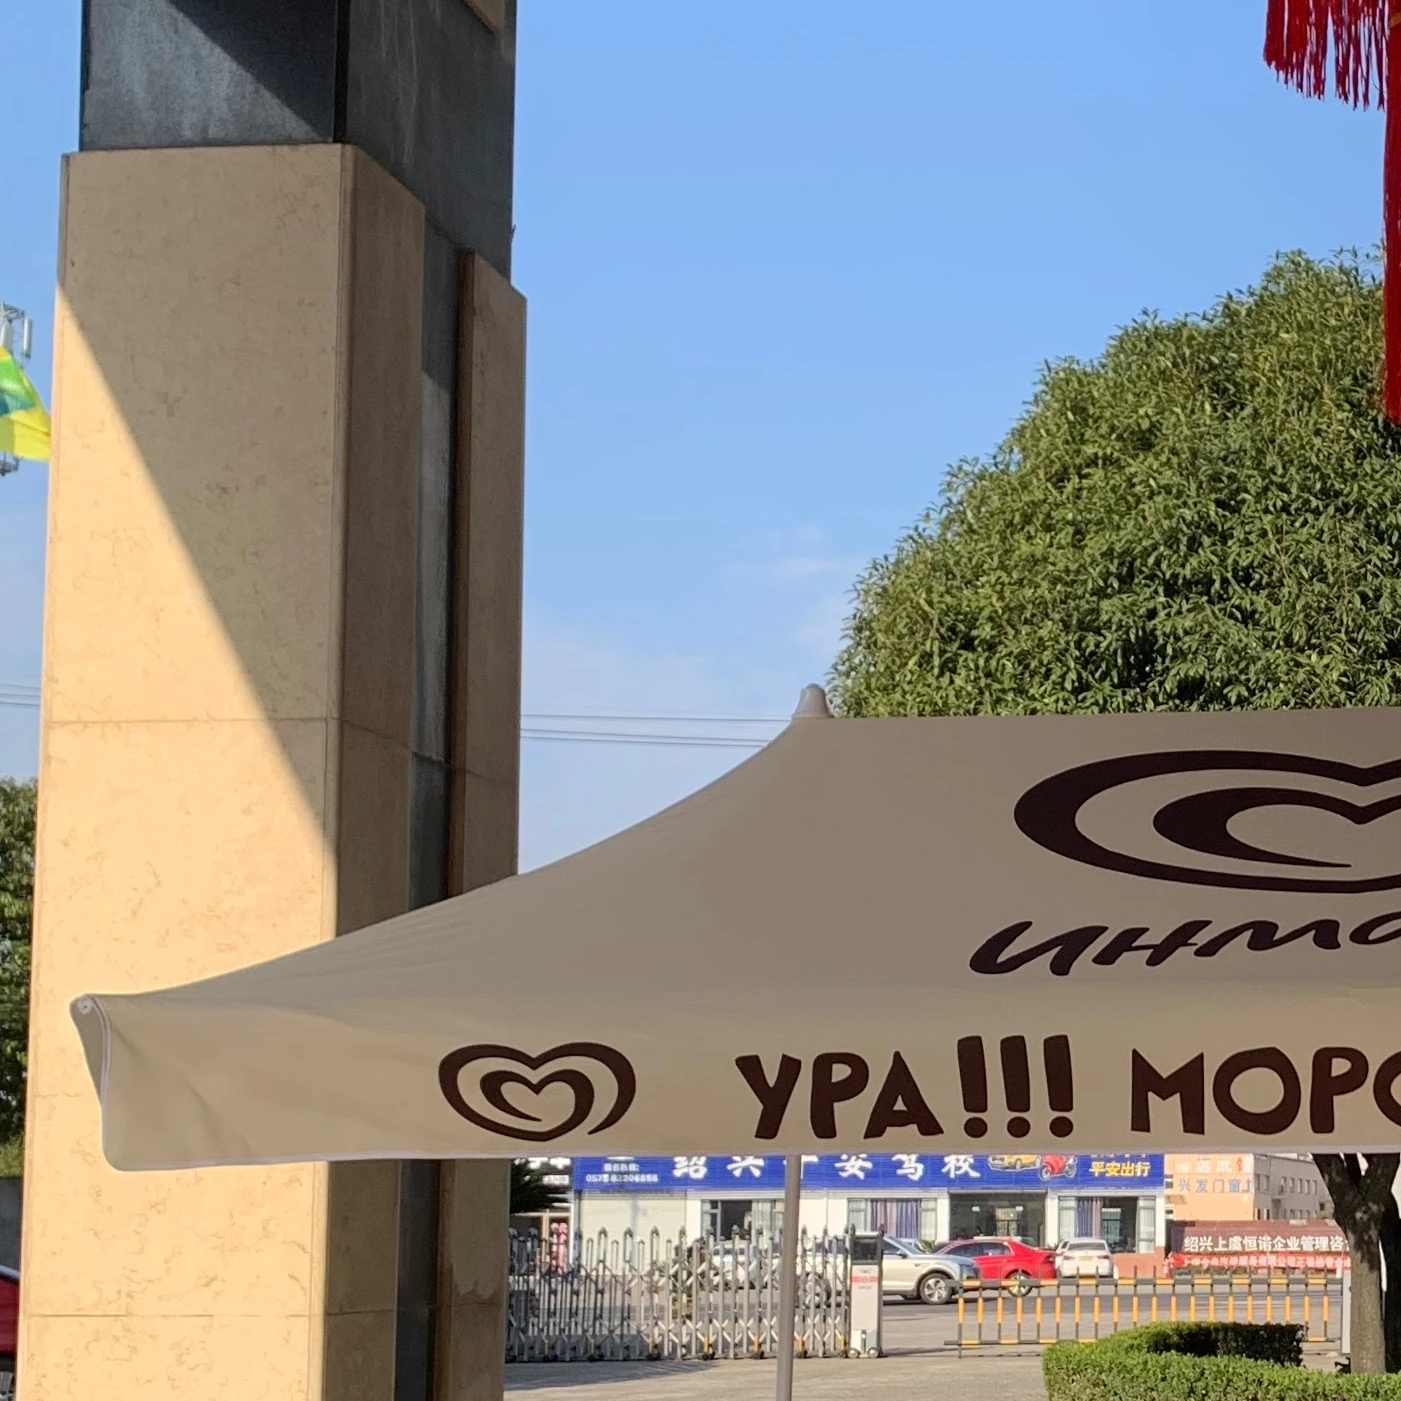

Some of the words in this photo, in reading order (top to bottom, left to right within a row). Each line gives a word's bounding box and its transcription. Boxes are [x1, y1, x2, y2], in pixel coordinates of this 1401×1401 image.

[734, 1034, 1074, 1140] УРА!!!
[1089, 1161, 1151, 1177] 平安出行
